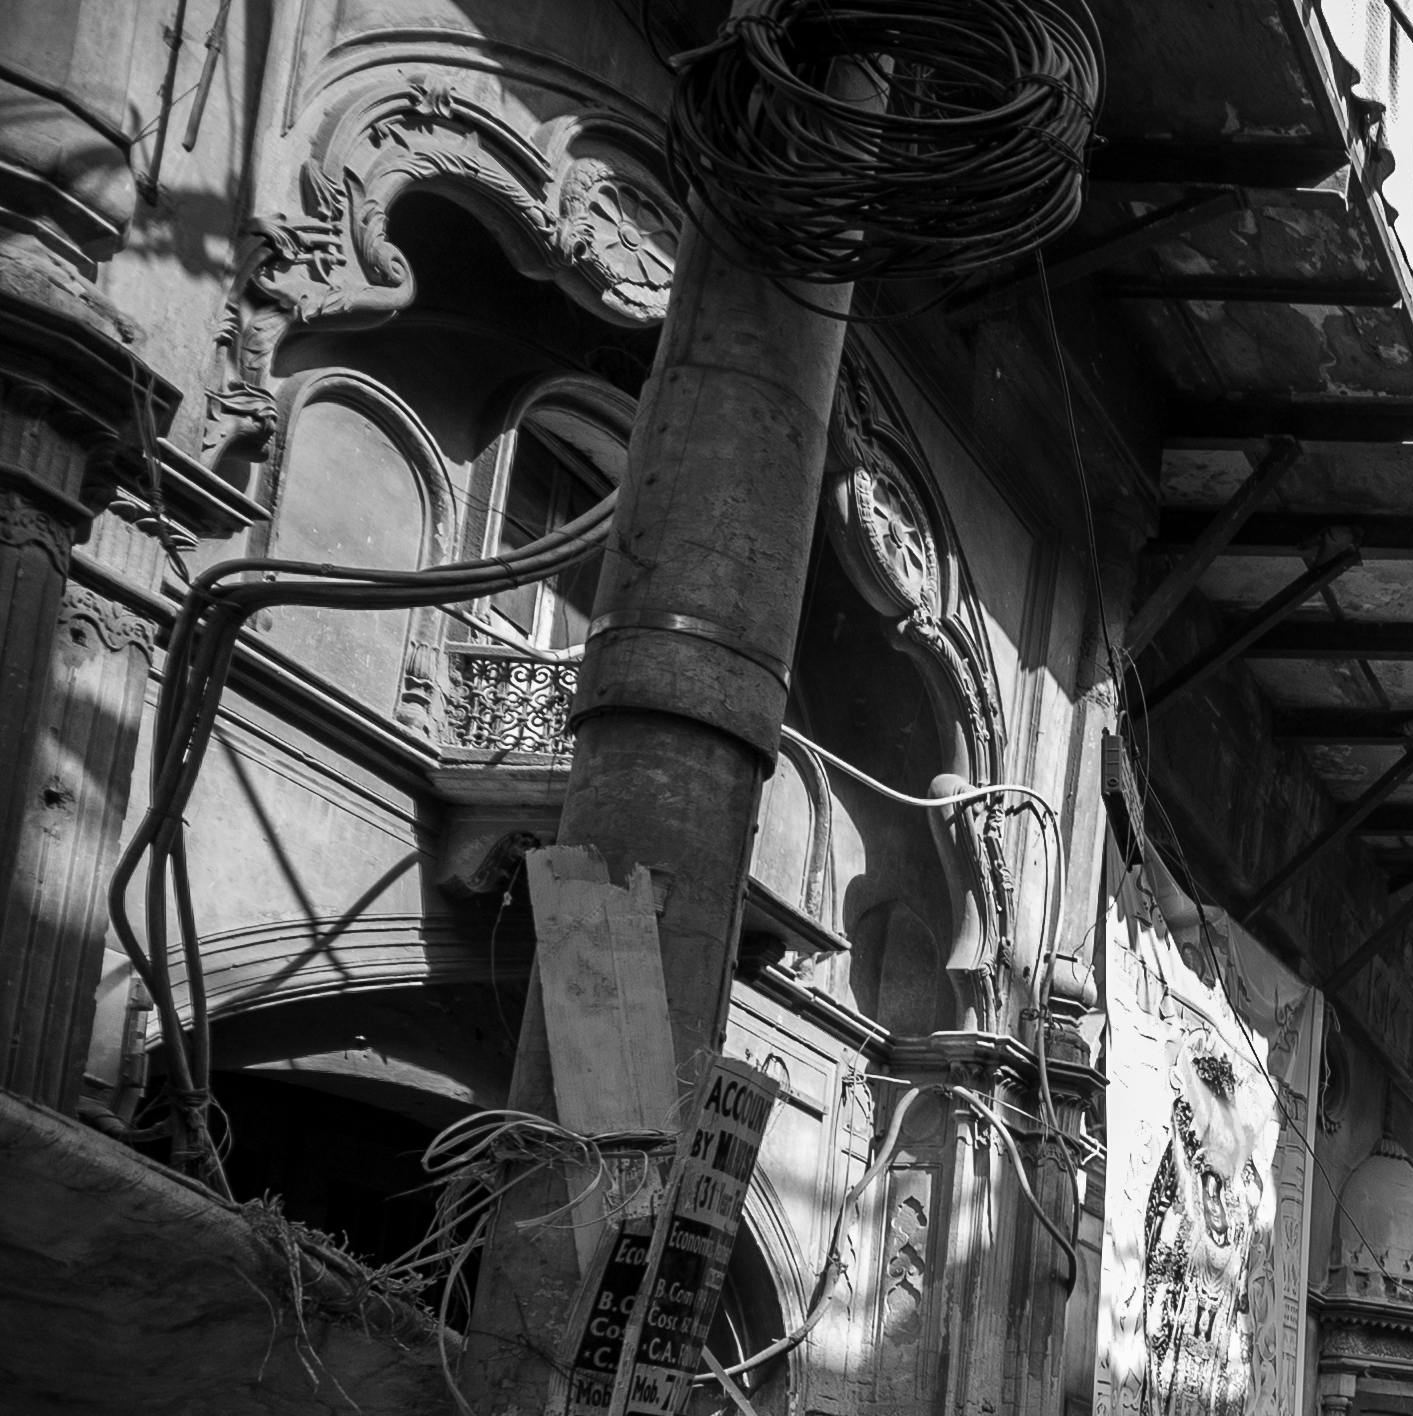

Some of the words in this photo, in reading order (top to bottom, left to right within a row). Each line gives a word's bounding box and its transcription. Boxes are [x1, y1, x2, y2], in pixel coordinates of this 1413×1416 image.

[690, 1128, 714, 1161] BY
[590, 1317, 626, 1340] Co
[632, 1375, 660, 1403] Mob.
